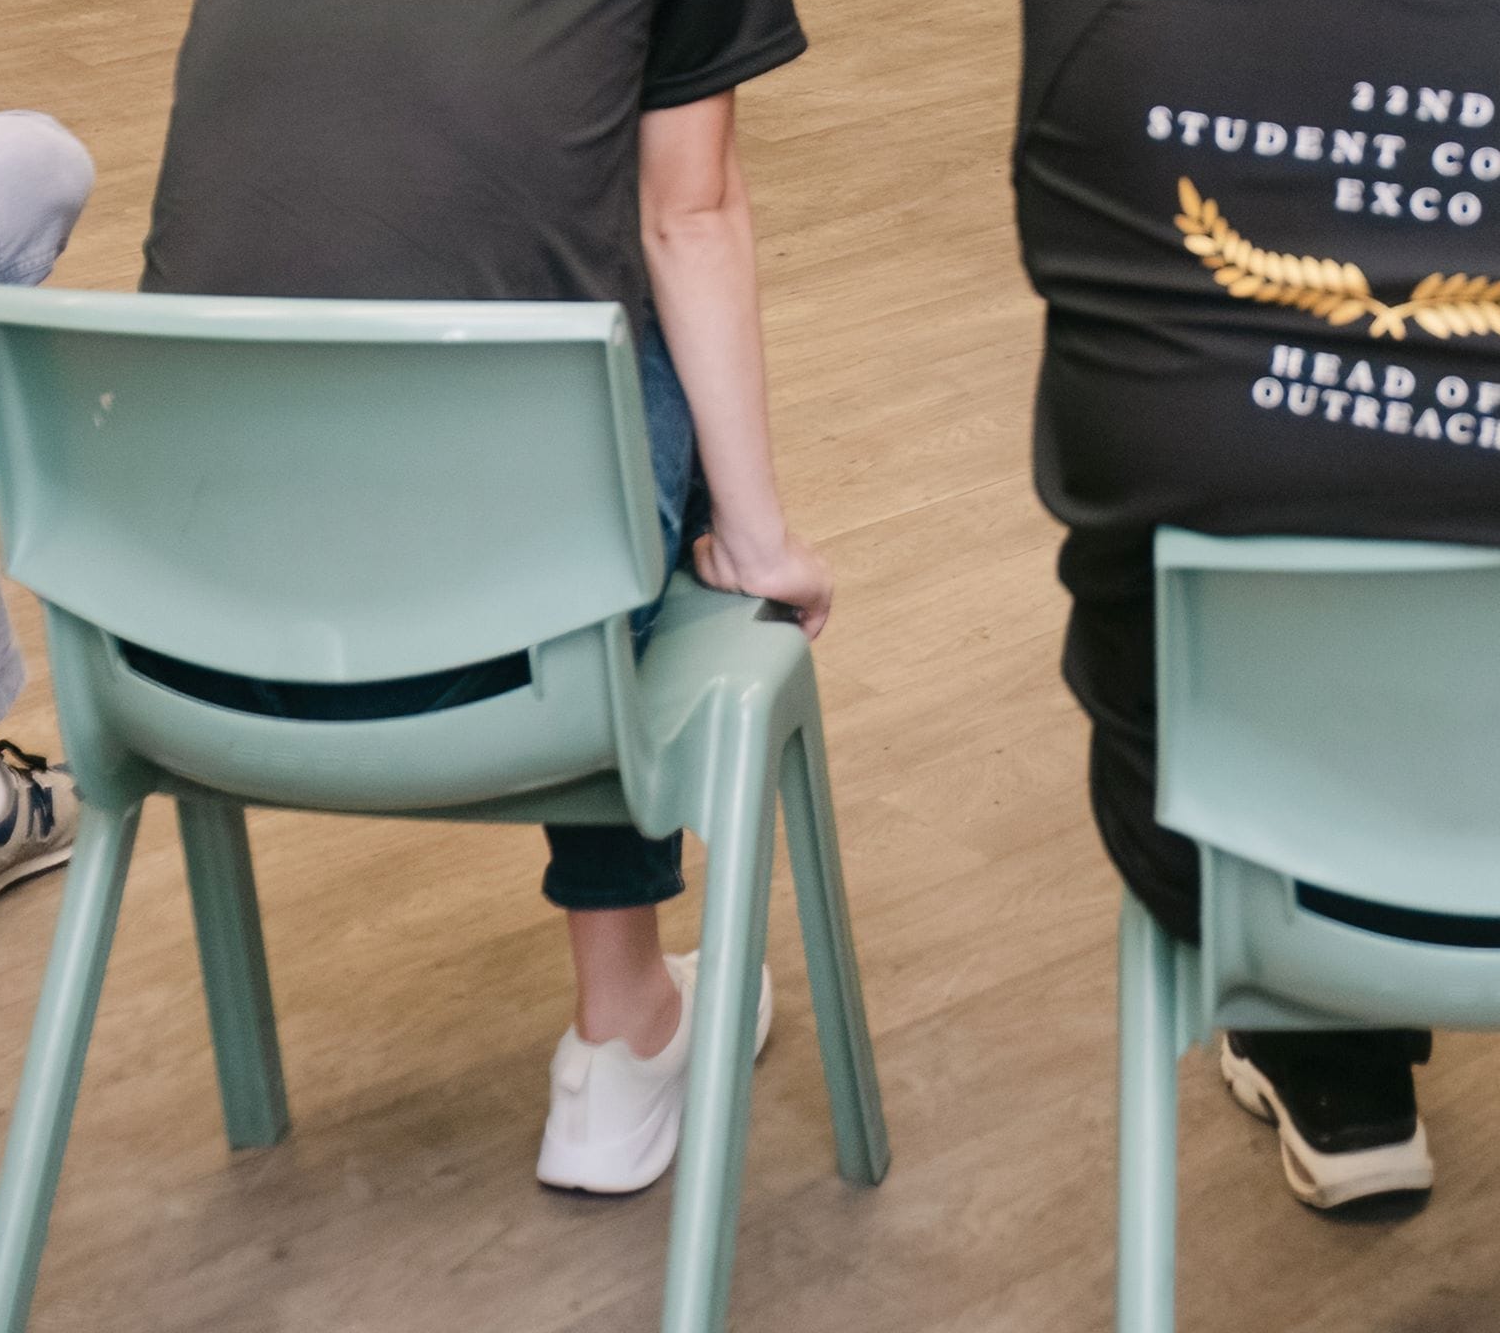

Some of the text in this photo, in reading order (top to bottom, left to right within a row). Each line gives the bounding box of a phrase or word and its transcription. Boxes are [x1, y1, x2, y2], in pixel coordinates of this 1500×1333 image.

[1349, 80, 1496, 129] 22ND
[1146, 104, 1406, 169] STUDENT
[1334, 176, 1484, 227] EXCO
[1270, 344, 1417, 400] HEAD
